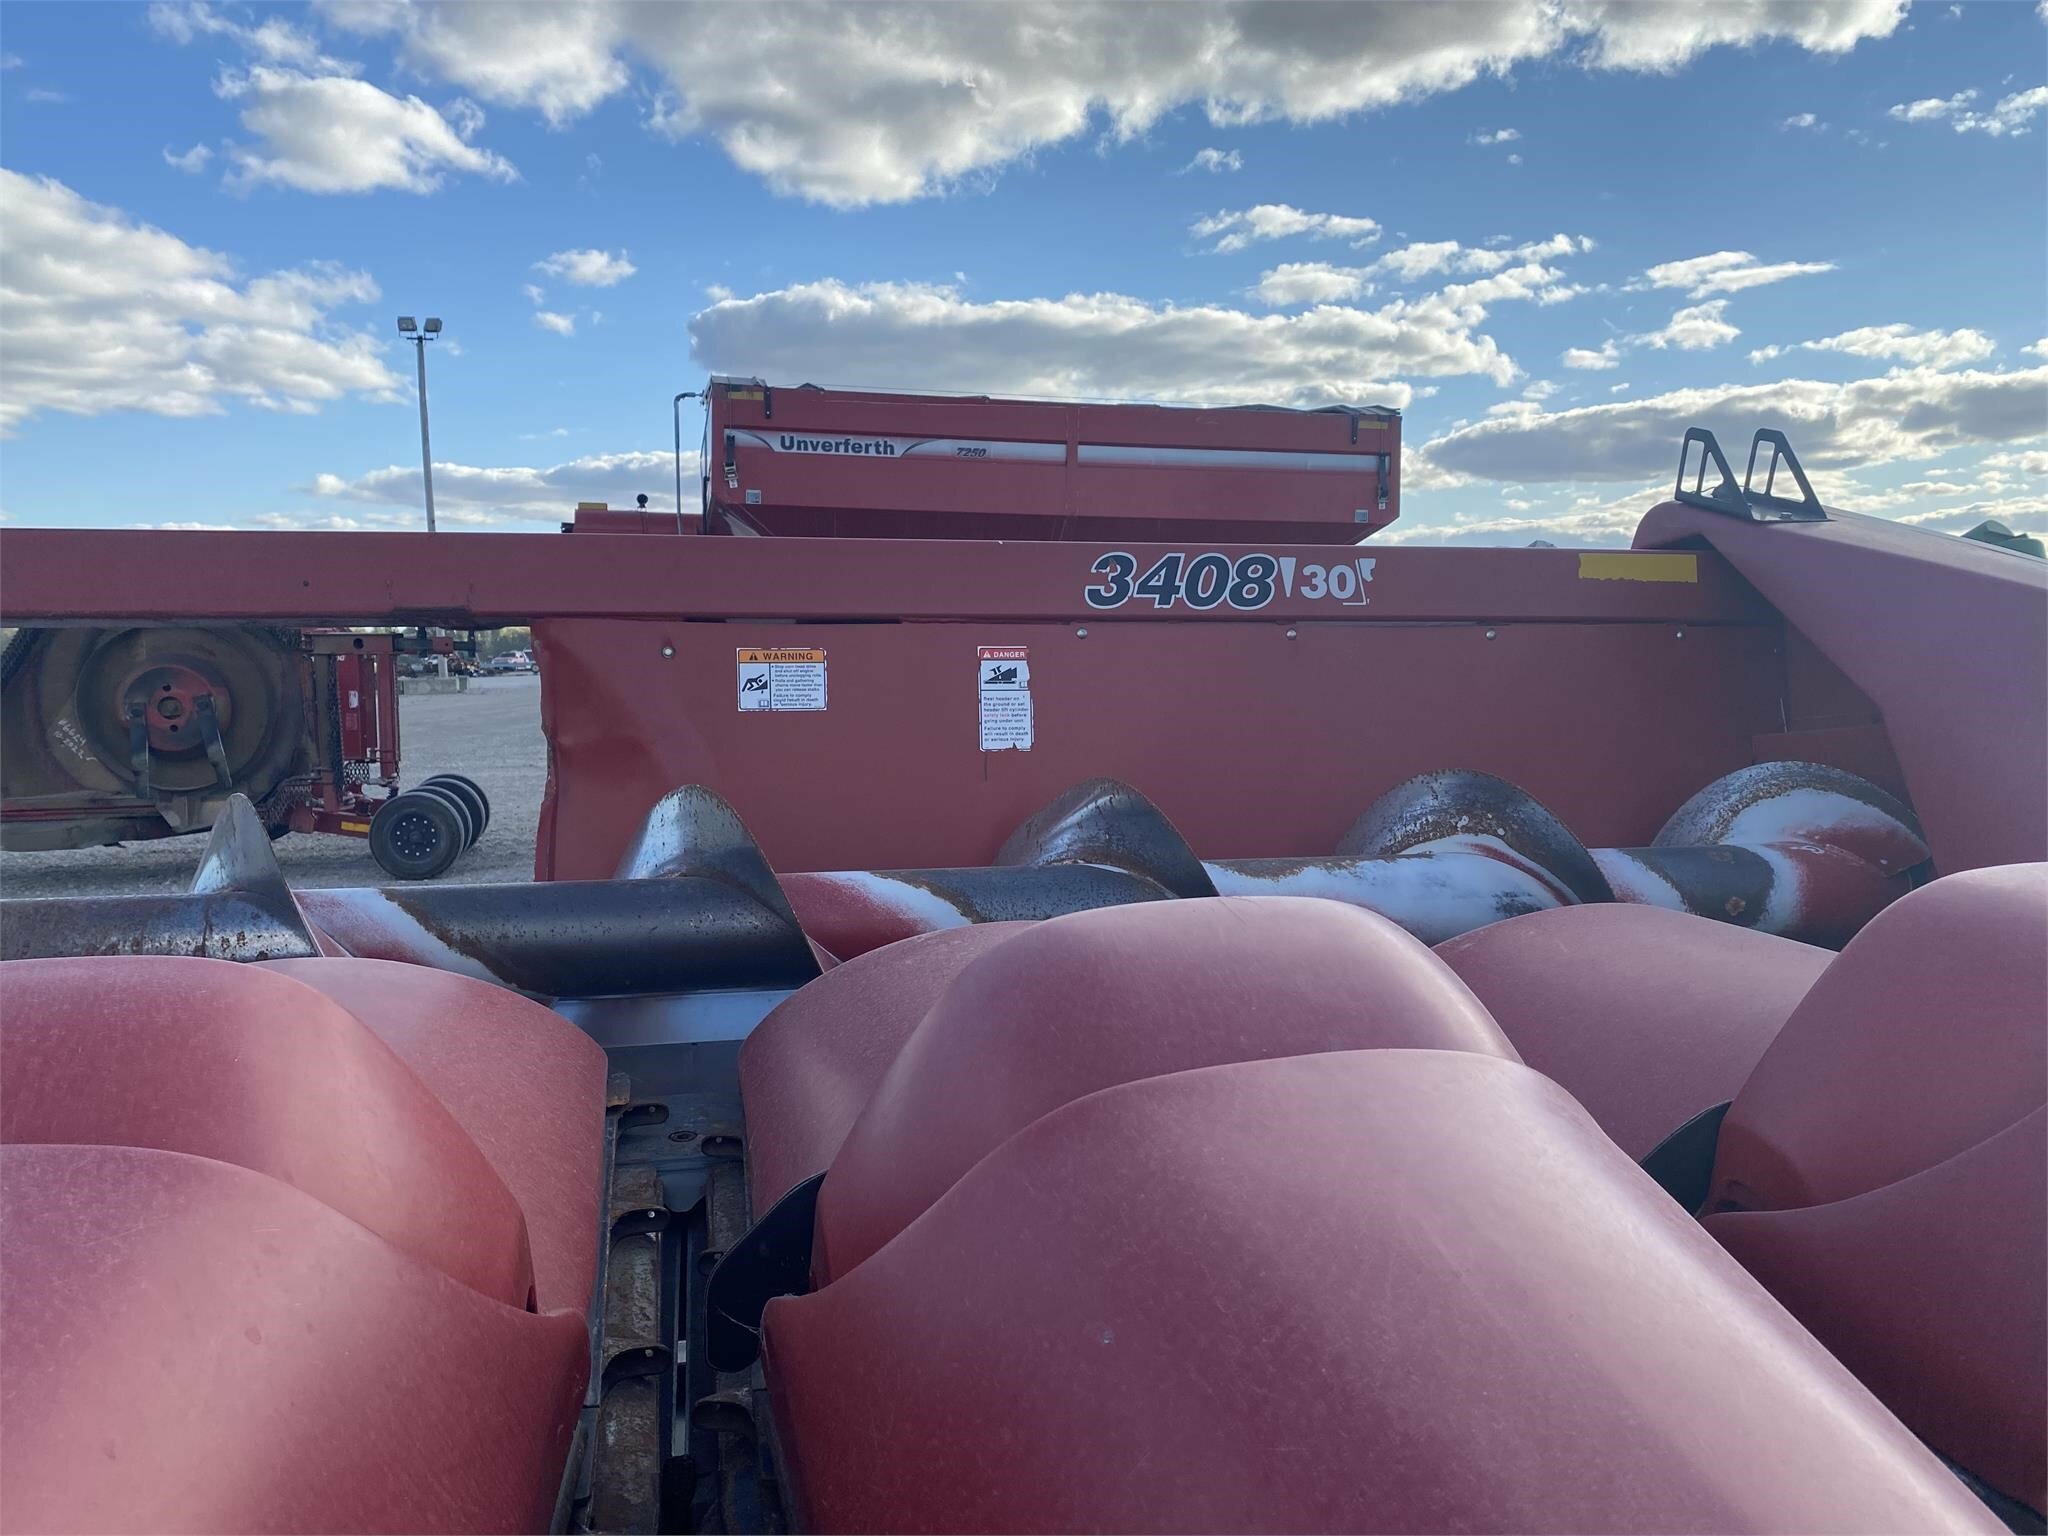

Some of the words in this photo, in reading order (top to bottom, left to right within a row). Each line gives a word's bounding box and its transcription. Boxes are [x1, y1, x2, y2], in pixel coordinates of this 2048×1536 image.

[780, 436, 895, 455] Unverferth
[956, 447, 987, 458] 7250
[1085, 552, 1278, 610] 3408
[1300, 564, 1356, 599] 30
